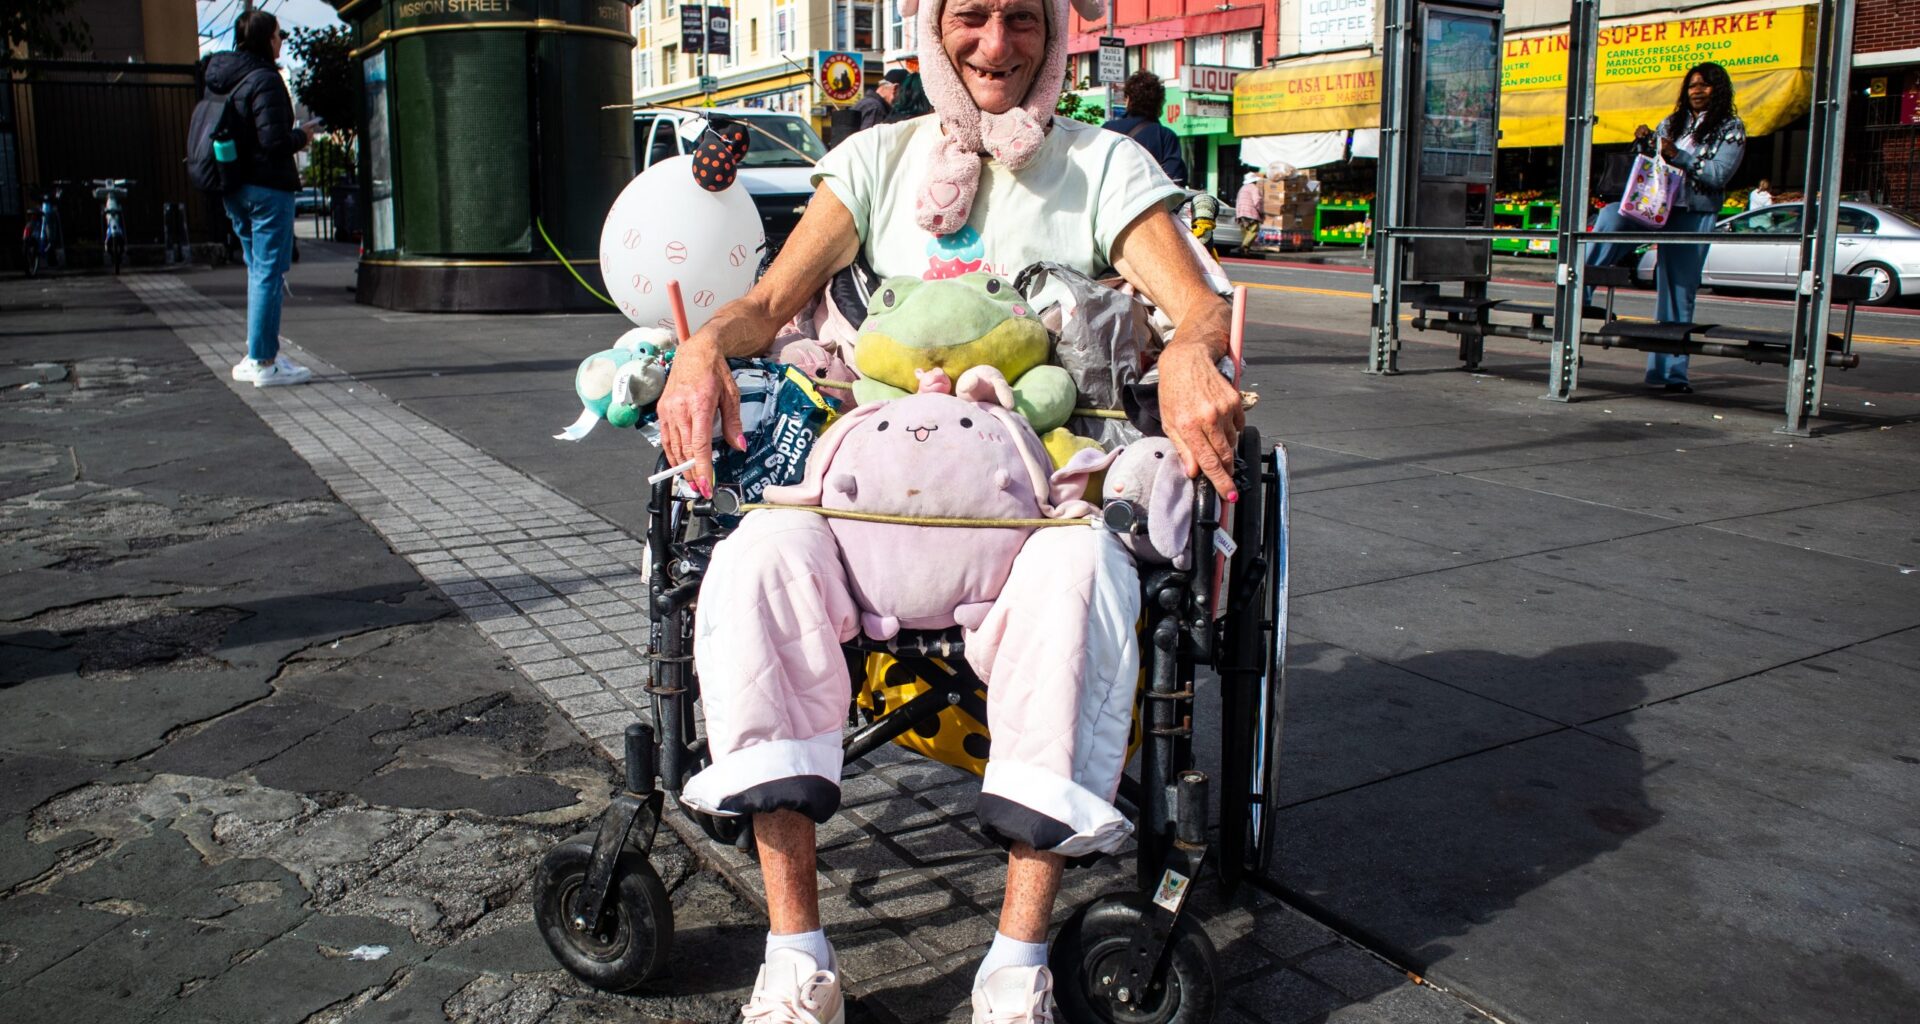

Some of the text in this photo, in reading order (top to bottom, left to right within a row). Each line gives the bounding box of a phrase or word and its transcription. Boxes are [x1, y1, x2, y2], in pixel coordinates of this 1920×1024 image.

[448, 0, 511, 12] STREET
[1310, 15, 1366, 34] COFFEE
[1598, 10, 1778, 46] SUPER MARKET
[1507, 34, 1569, 57] LATIN
[1607, 40, 1732, 59] CARNES FRESCAS POLLO
[1504, 62, 1529, 71] ULTRY
[1606, 56, 1657, 67] MARISCOS
[1660, 52, 1705, 63] FRESCOS
[1606, 65, 1661, 76] PRODUCTO
[1669, 62, 1683, 71] DE
[1288, 78, 1320, 94] CASA
[1326, 71, 1376, 91] LATINA
[1520, 74, 1562, 85] PRODUCE
[1300, 90, 1376, 106] SUPER MARKET
